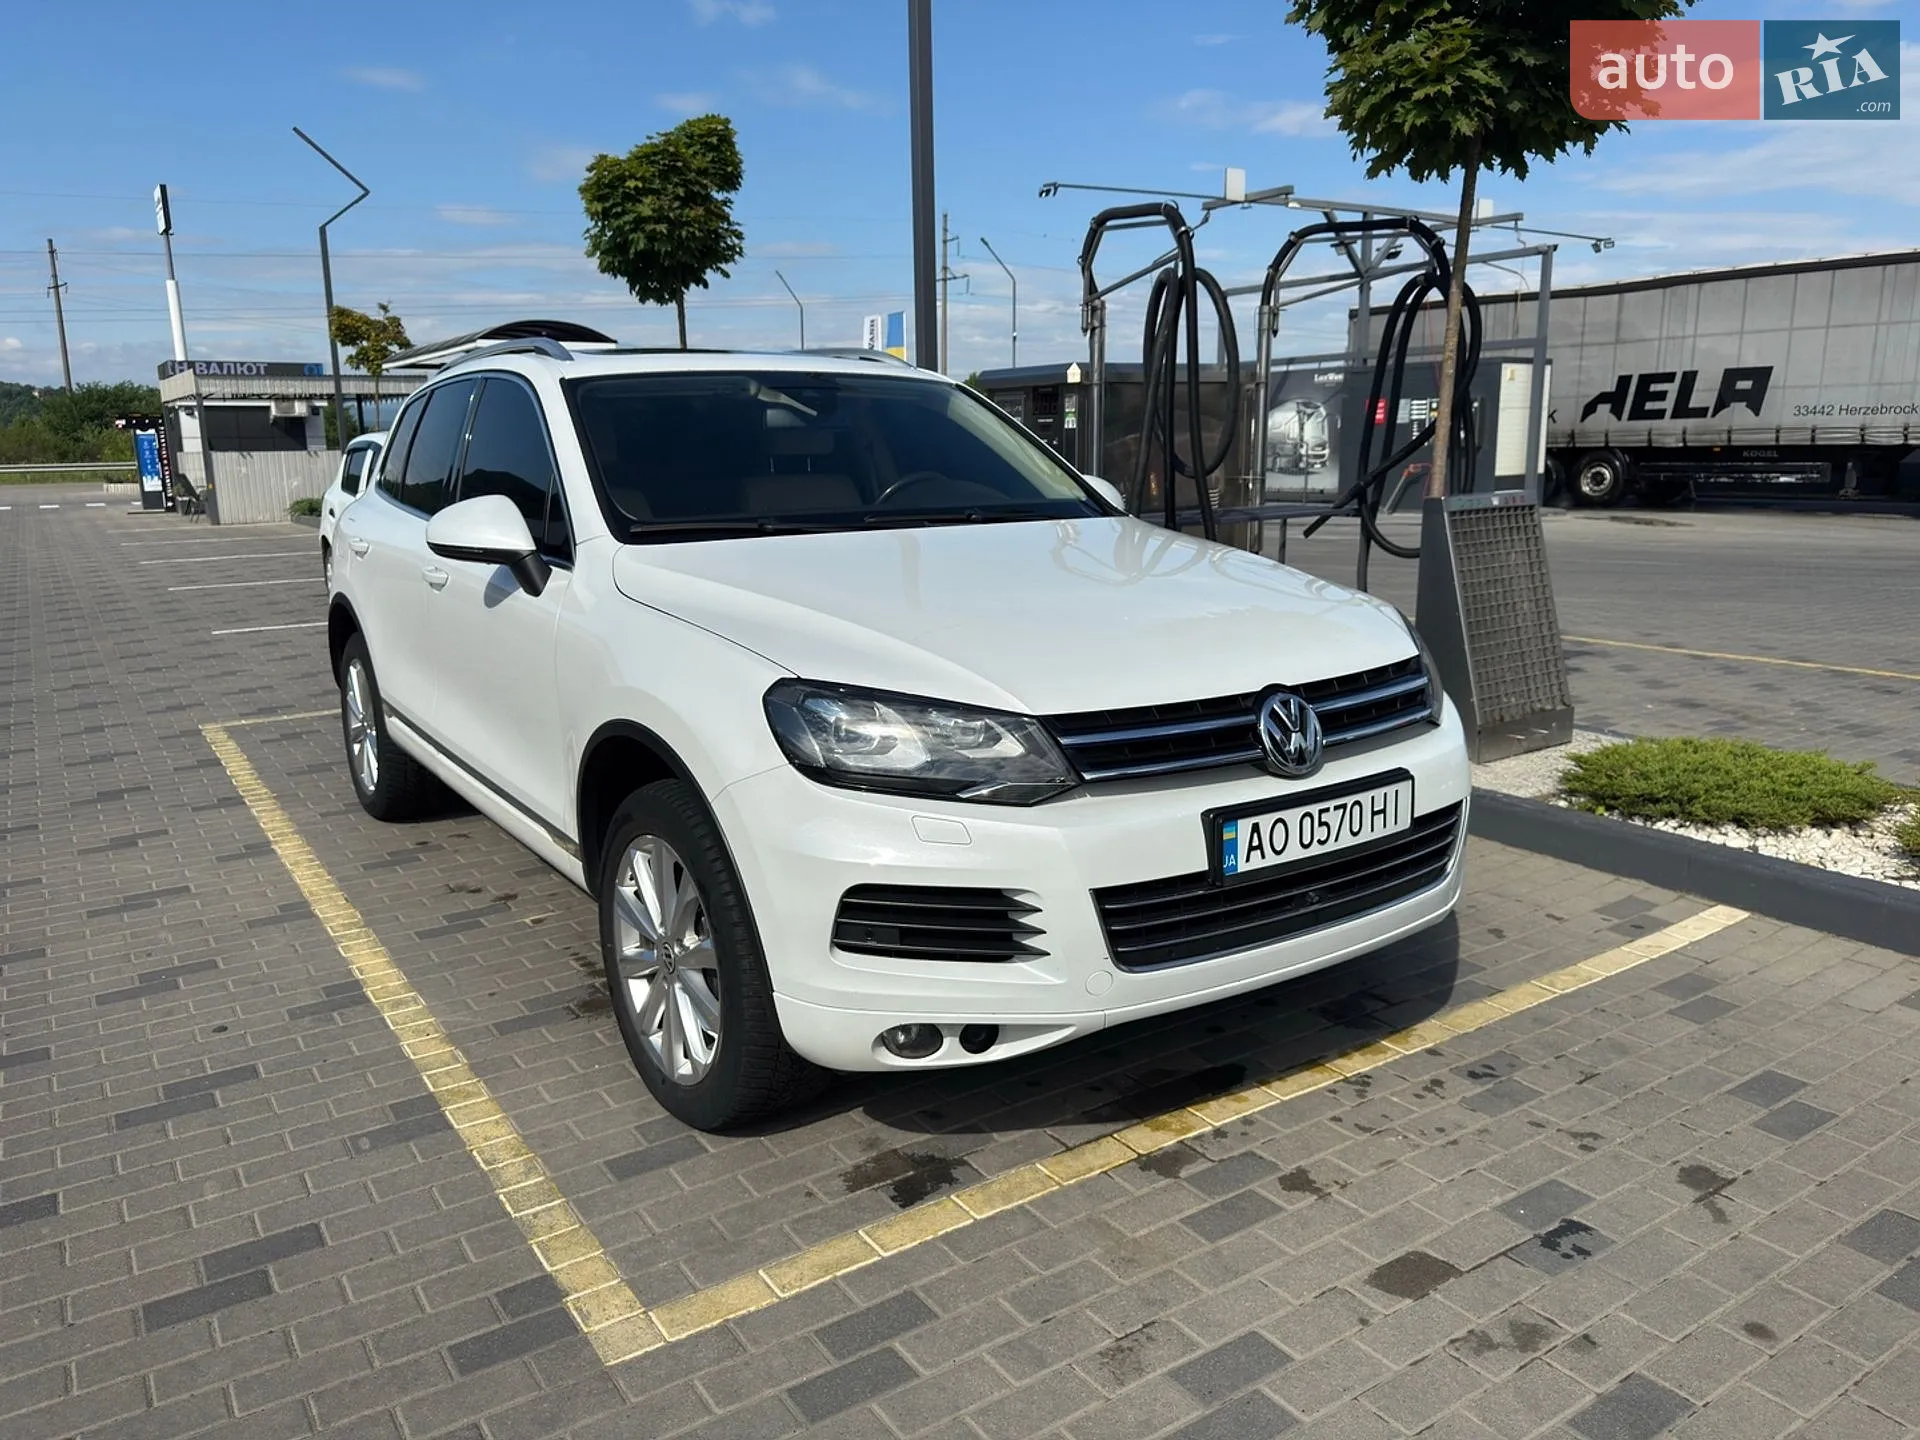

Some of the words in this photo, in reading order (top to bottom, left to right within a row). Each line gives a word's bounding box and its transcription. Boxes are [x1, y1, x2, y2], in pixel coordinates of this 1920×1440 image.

[194, 362, 269, 376] ВАЛЮТ
[1579, 366, 1774, 423] HELA
[1793, 404, 1834, 417] 33442
[1838, 402, 1919, 416] Herzebrock
[1245, 817, 1290, 864] AO
[1298, 800, 1364, 851] 0570
[1370, 789, 1400, 833] HI
